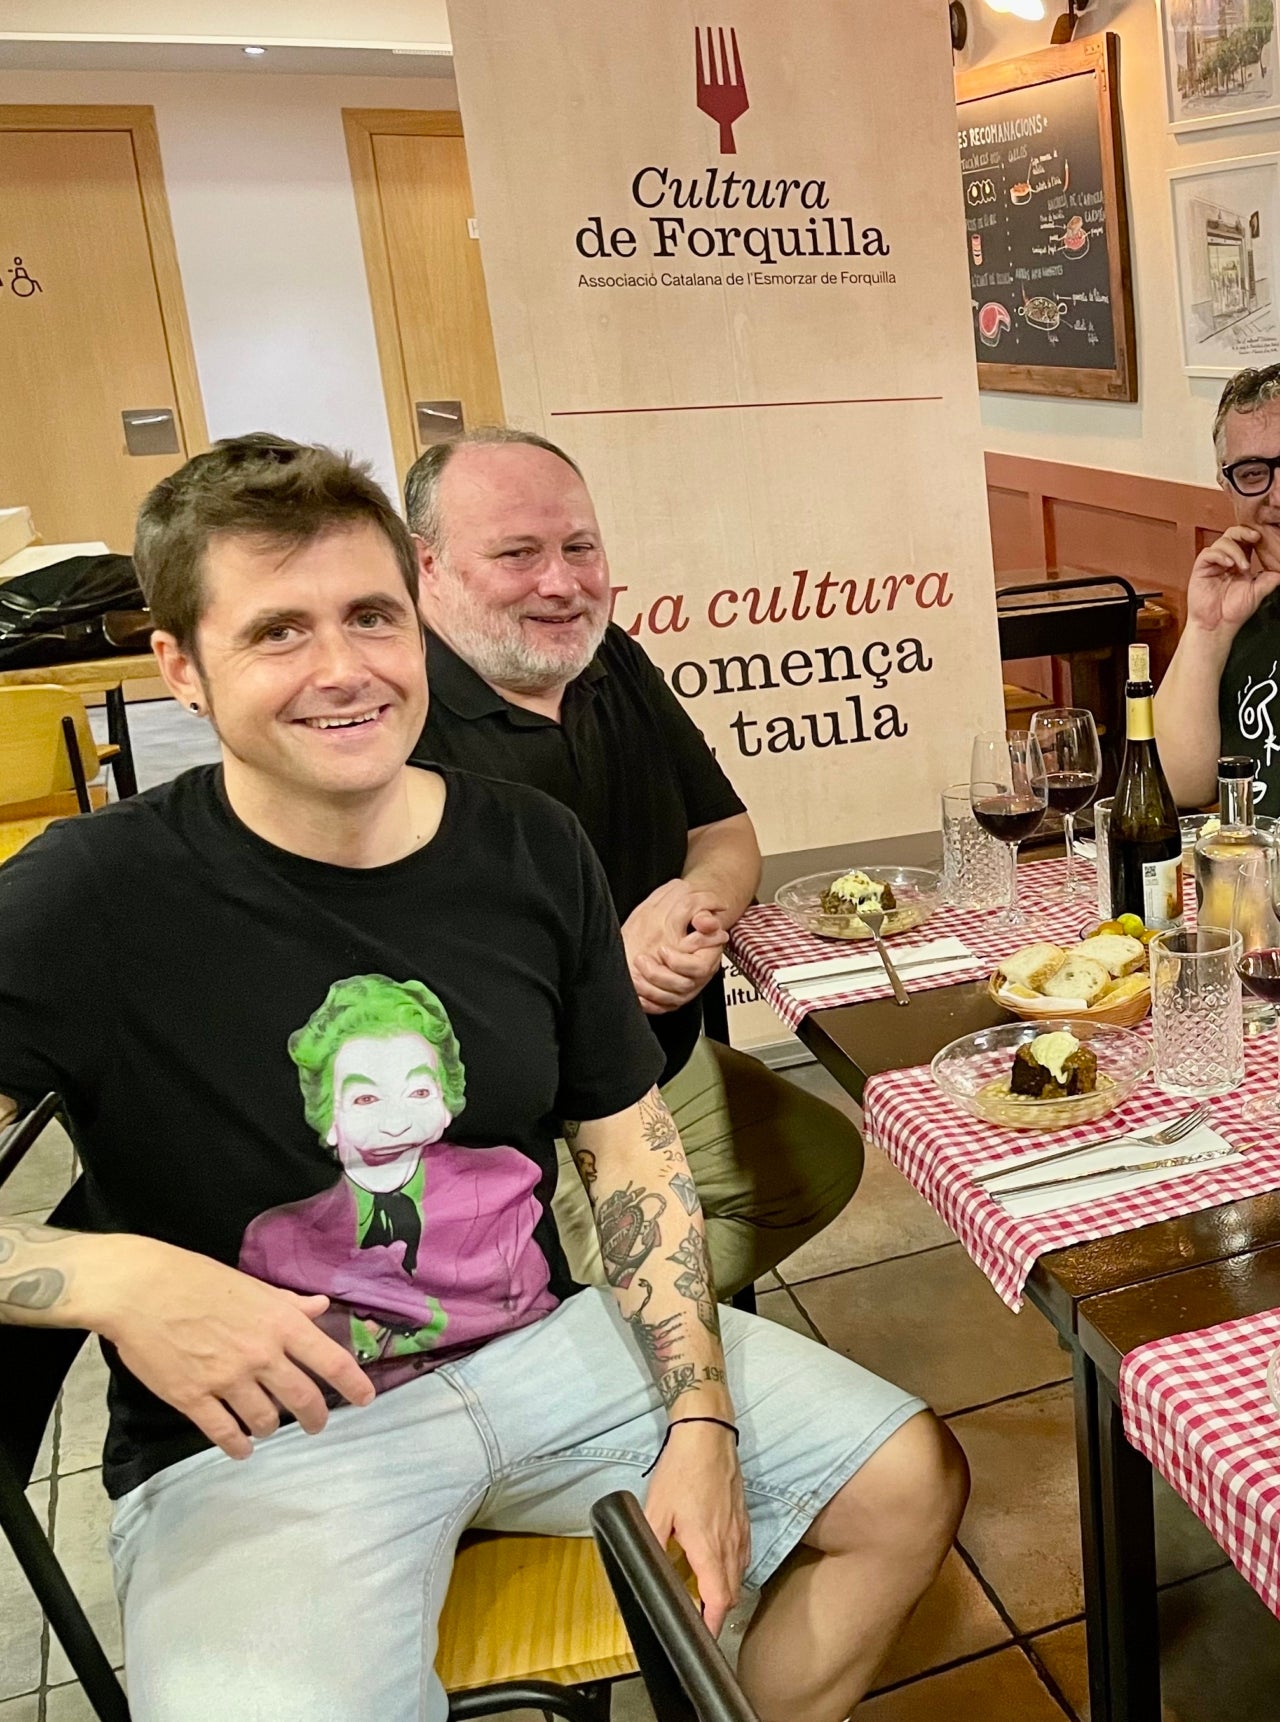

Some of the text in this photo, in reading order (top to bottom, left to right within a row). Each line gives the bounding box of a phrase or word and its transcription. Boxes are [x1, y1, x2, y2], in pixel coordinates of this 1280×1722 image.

[969, 113, 1043, 147] RECOMANACIONS
[632, 166, 830, 209] Cultura
[575, 217, 890, 264] de Forquilla
[578, 270, 897, 288] Associació Catalana de l'Esmorzar de Forquilla
[707, 569, 954, 629] cultura
[655, 636, 933, 699] omença
[729, 694, 908, 757] taula
